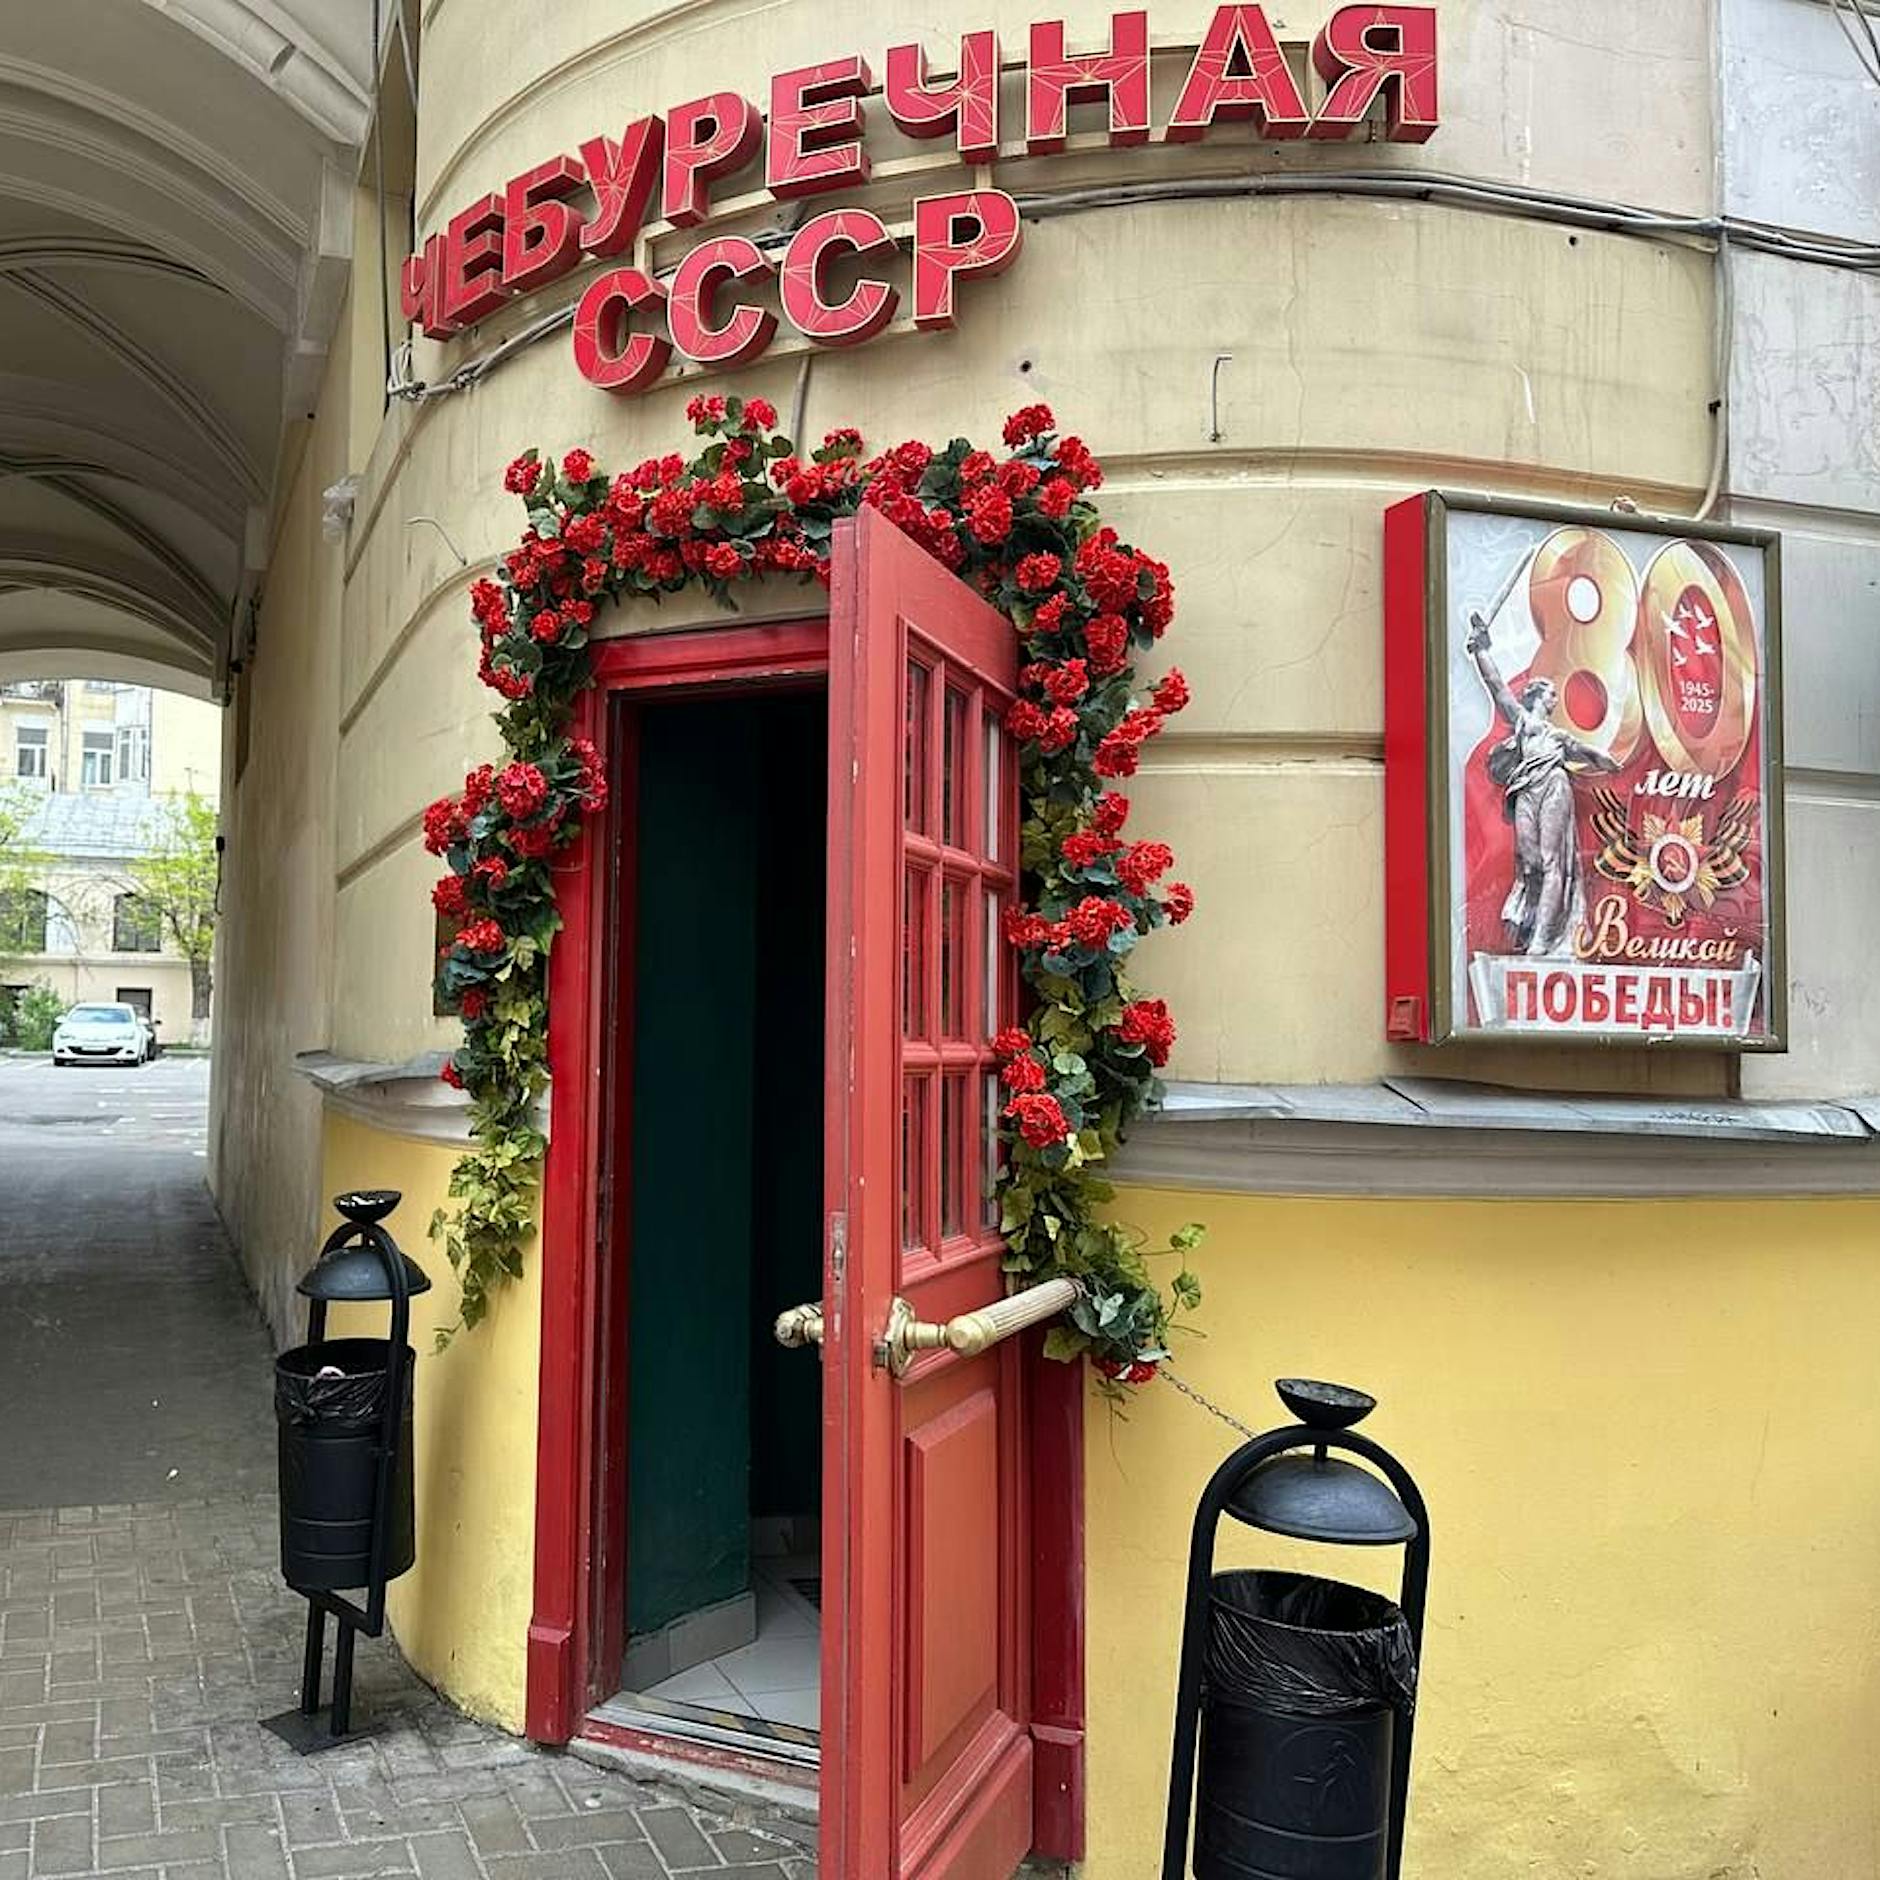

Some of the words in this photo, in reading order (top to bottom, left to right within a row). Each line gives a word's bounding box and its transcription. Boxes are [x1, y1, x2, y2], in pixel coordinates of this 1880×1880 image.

[401, 4, 1438, 341] ЧЕБУРЕЧНАЯ
[573, 188, 1022, 394] СССР
[1529, 524, 1757, 783] 80
[1680, 696, 1714, 714] 2025
[1634, 769, 1716, 800] лет
[1574, 894, 1736, 963] Великой
[1505, 970, 1733, 1031] ПОБЕДЫ!
